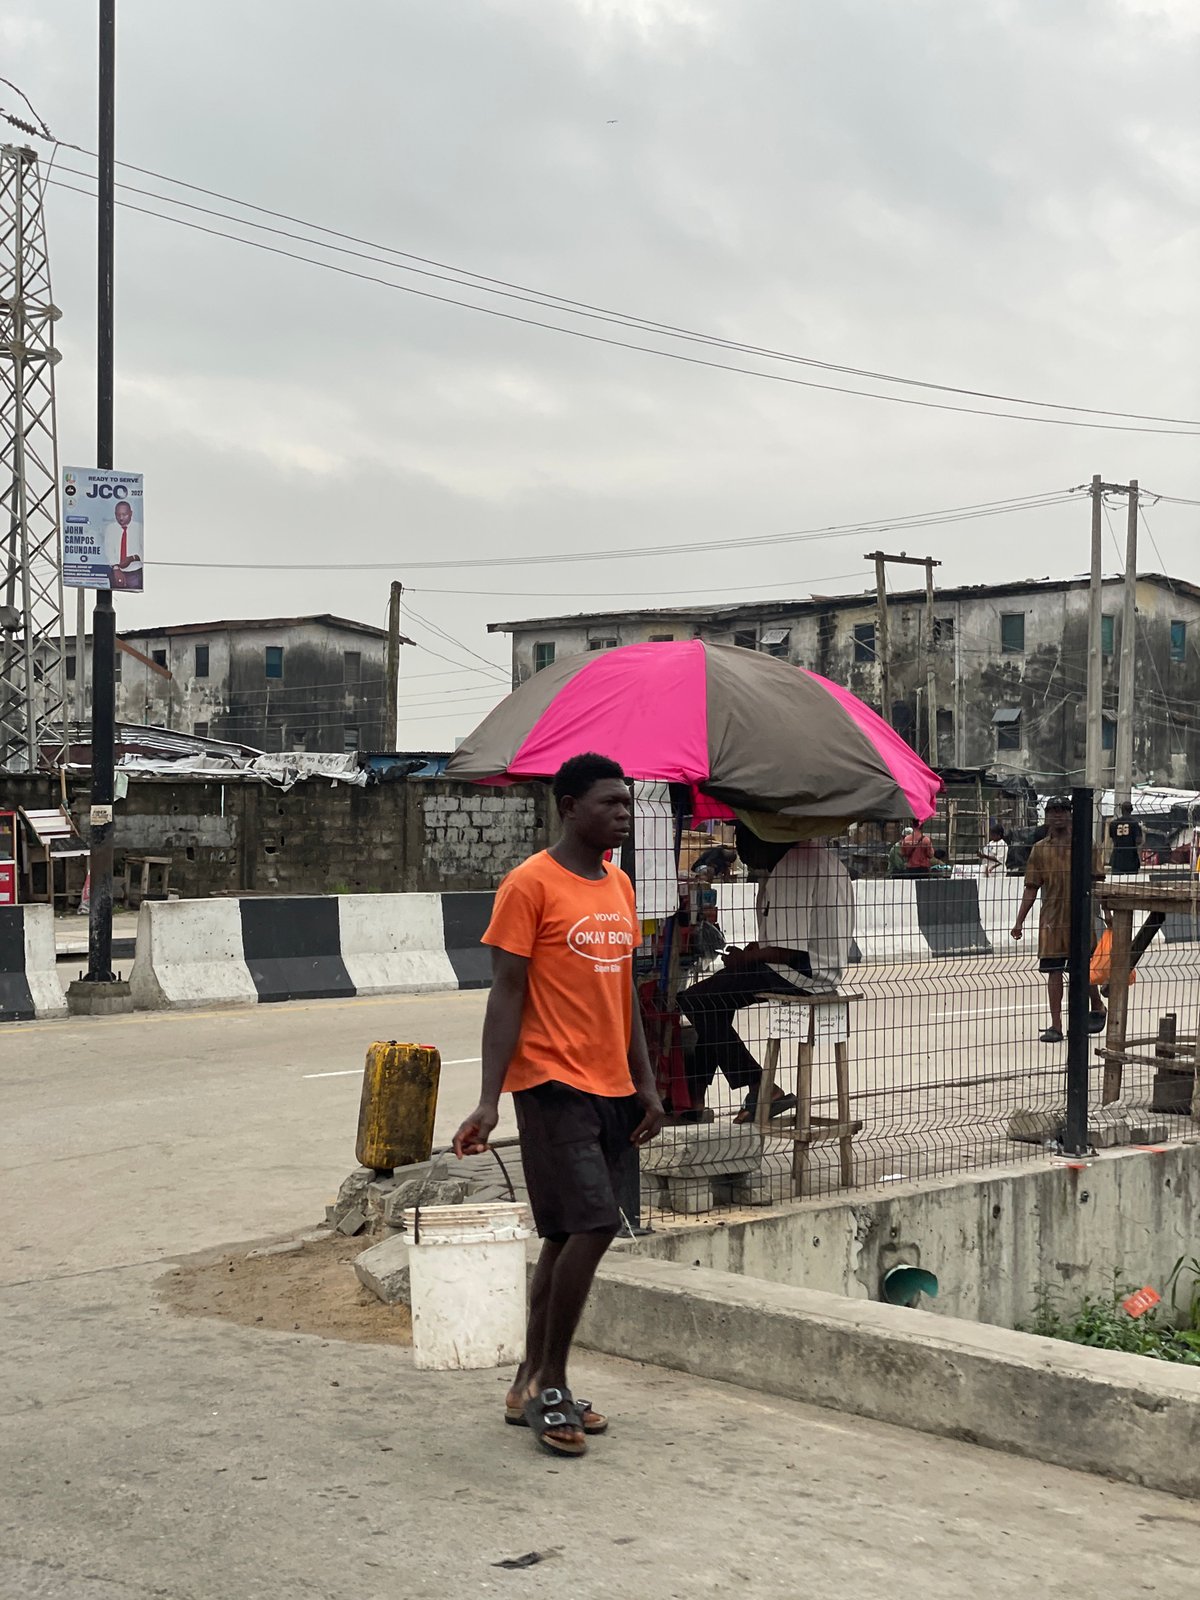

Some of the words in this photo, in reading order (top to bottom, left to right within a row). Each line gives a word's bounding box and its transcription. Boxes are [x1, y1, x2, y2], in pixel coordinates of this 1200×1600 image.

[86, 484, 128, 499] JCO
[65, 526, 83, 534] JOHN
[65, 536, 94, 545] CAMPOS
[65, 546, 100, 555] OGUNDARE
[575, 931, 605, 945] OKAY
